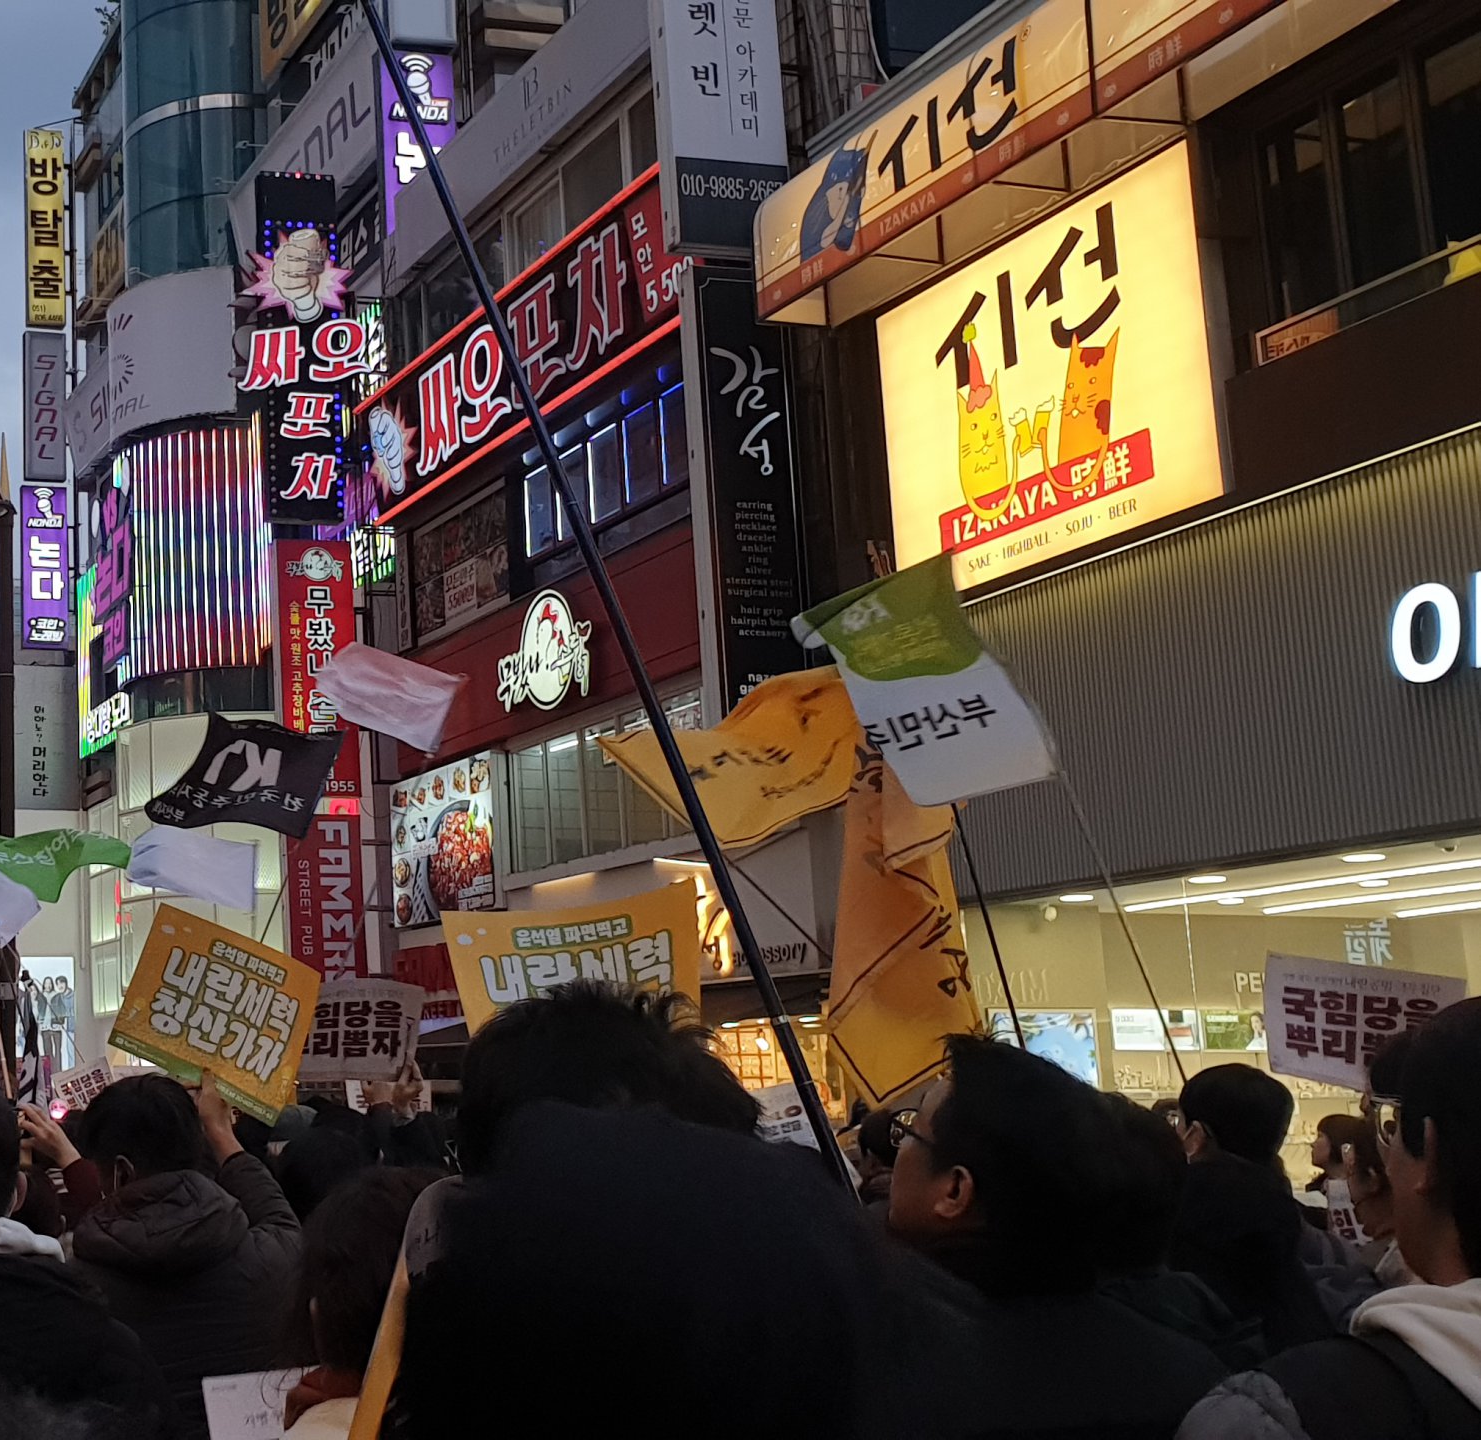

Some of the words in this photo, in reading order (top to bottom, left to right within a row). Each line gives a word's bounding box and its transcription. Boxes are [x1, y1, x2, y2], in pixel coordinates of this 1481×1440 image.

[736, 41, 759, 138] 아카데미
[29, 157, 63, 300] 방탈출
[879, 191, 936, 237] IZAKAYA
[238, 318, 371, 391] 싸오
[34, 354, 57, 461] SIGNAL
[709, 345, 781, 476] 감성
[280, 391, 337, 500] 포차
[735, 512, 775, 523] piercing
[736, 501, 773, 511] earring
[952, 481, 1059, 545] IZAKAYA
[27, 517, 63, 529] NONDA
[735, 522, 777, 532] necklace
[968, 552, 992, 573] SAKE
[1002, 531, 1052, 560] HIGHBALL
[1065, 515, 1094, 536] SOJU
[1108, 498, 1137, 520] BEER
[741, 544, 773, 554] anklet
[748, 555, 769, 566] ring
[27, 535, 65, 601] 논다
[745, 566, 772, 576] silver
[727, 587, 768, 598] surgical
[730, 615, 767, 628] hairpin
[740, 605, 761, 615] hair
[763, 606, 784, 617] grip
[738, 628, 788, 640] accessory
[290, 643, 302, 667] 원조
[32, 745, 50, 798] 머리한다
[298, 860, 312, 917] STREET
[301, 926, 314, 956] PUB
[516, 928, 562, 947] 윤석열
[212, 941, 248, 968] 윤석열
[480, 932, 671, 1003] 내란세력
[162, 947, 300, 1043] 내란세력
[1236, 972, 1265, 993] PE
[1282, 985, 1438, 1032] 국힘당을
[149, 985, 286, 1082] 청산가자
[302, 1030, 401, 1058] 리뽑자
